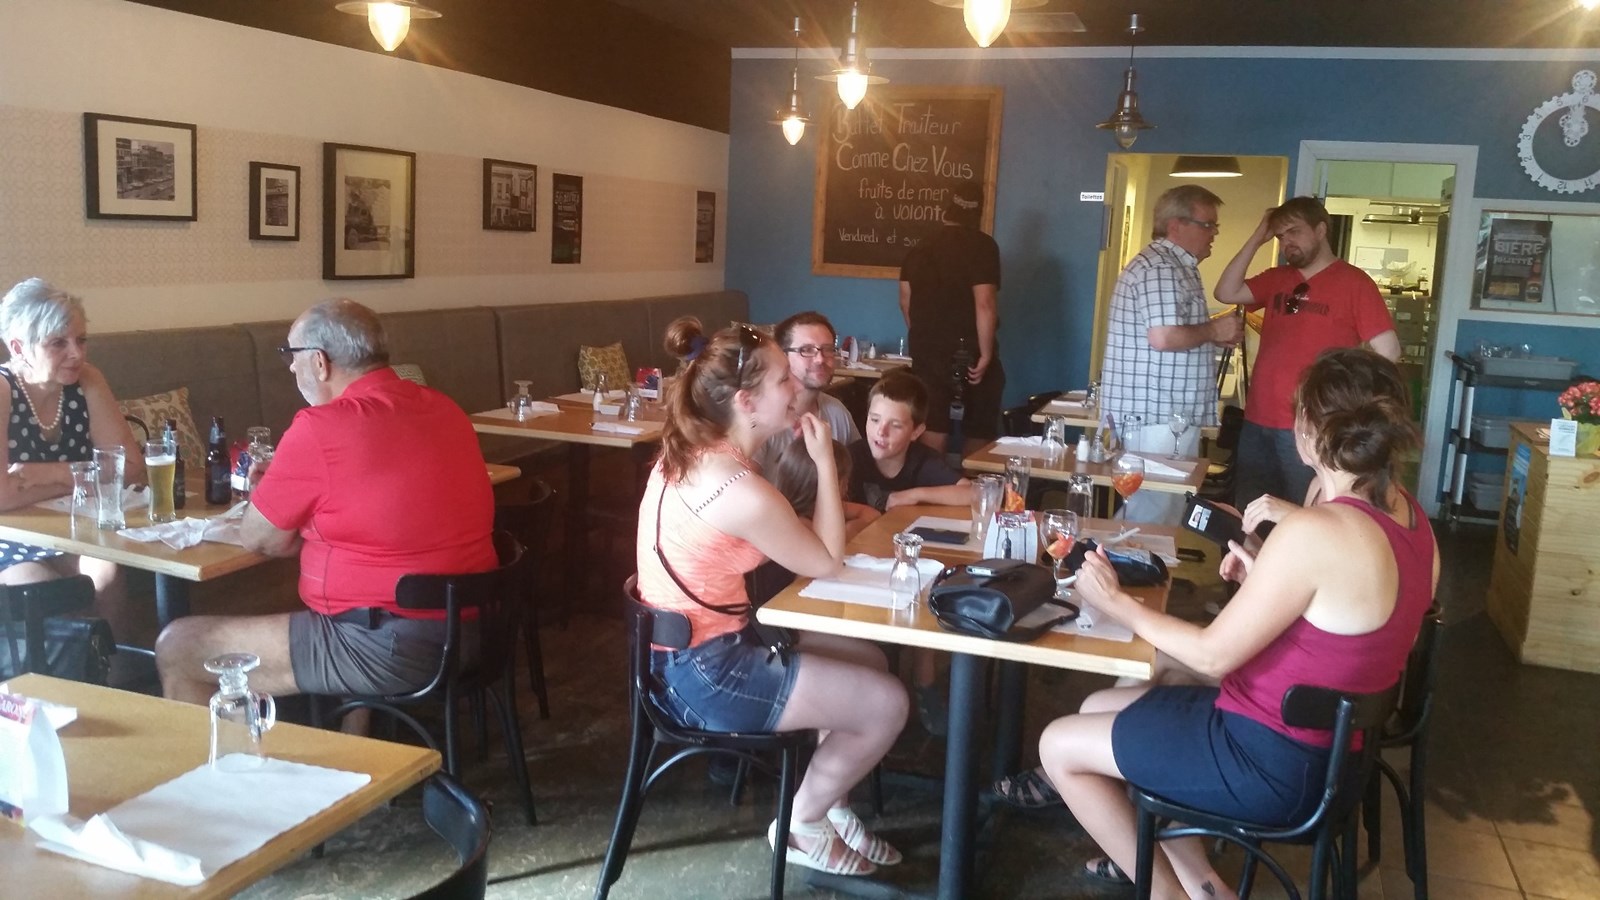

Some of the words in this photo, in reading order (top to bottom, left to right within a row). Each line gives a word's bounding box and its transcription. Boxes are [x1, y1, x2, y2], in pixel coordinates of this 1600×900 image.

[893, 102, 962, 136] Traiteur
[836, 142, 890, 171] Comme
[892, 142, 929, 173] Chez
[932, 145, 973, 179] Vous
[858, 178, 894, 199] fruits
[897, 180, 915, 200] de
[918, 187, 949, 201] mer
[838, 227, 879, 244] Vendredi
[886, 228, 897, 244] et
